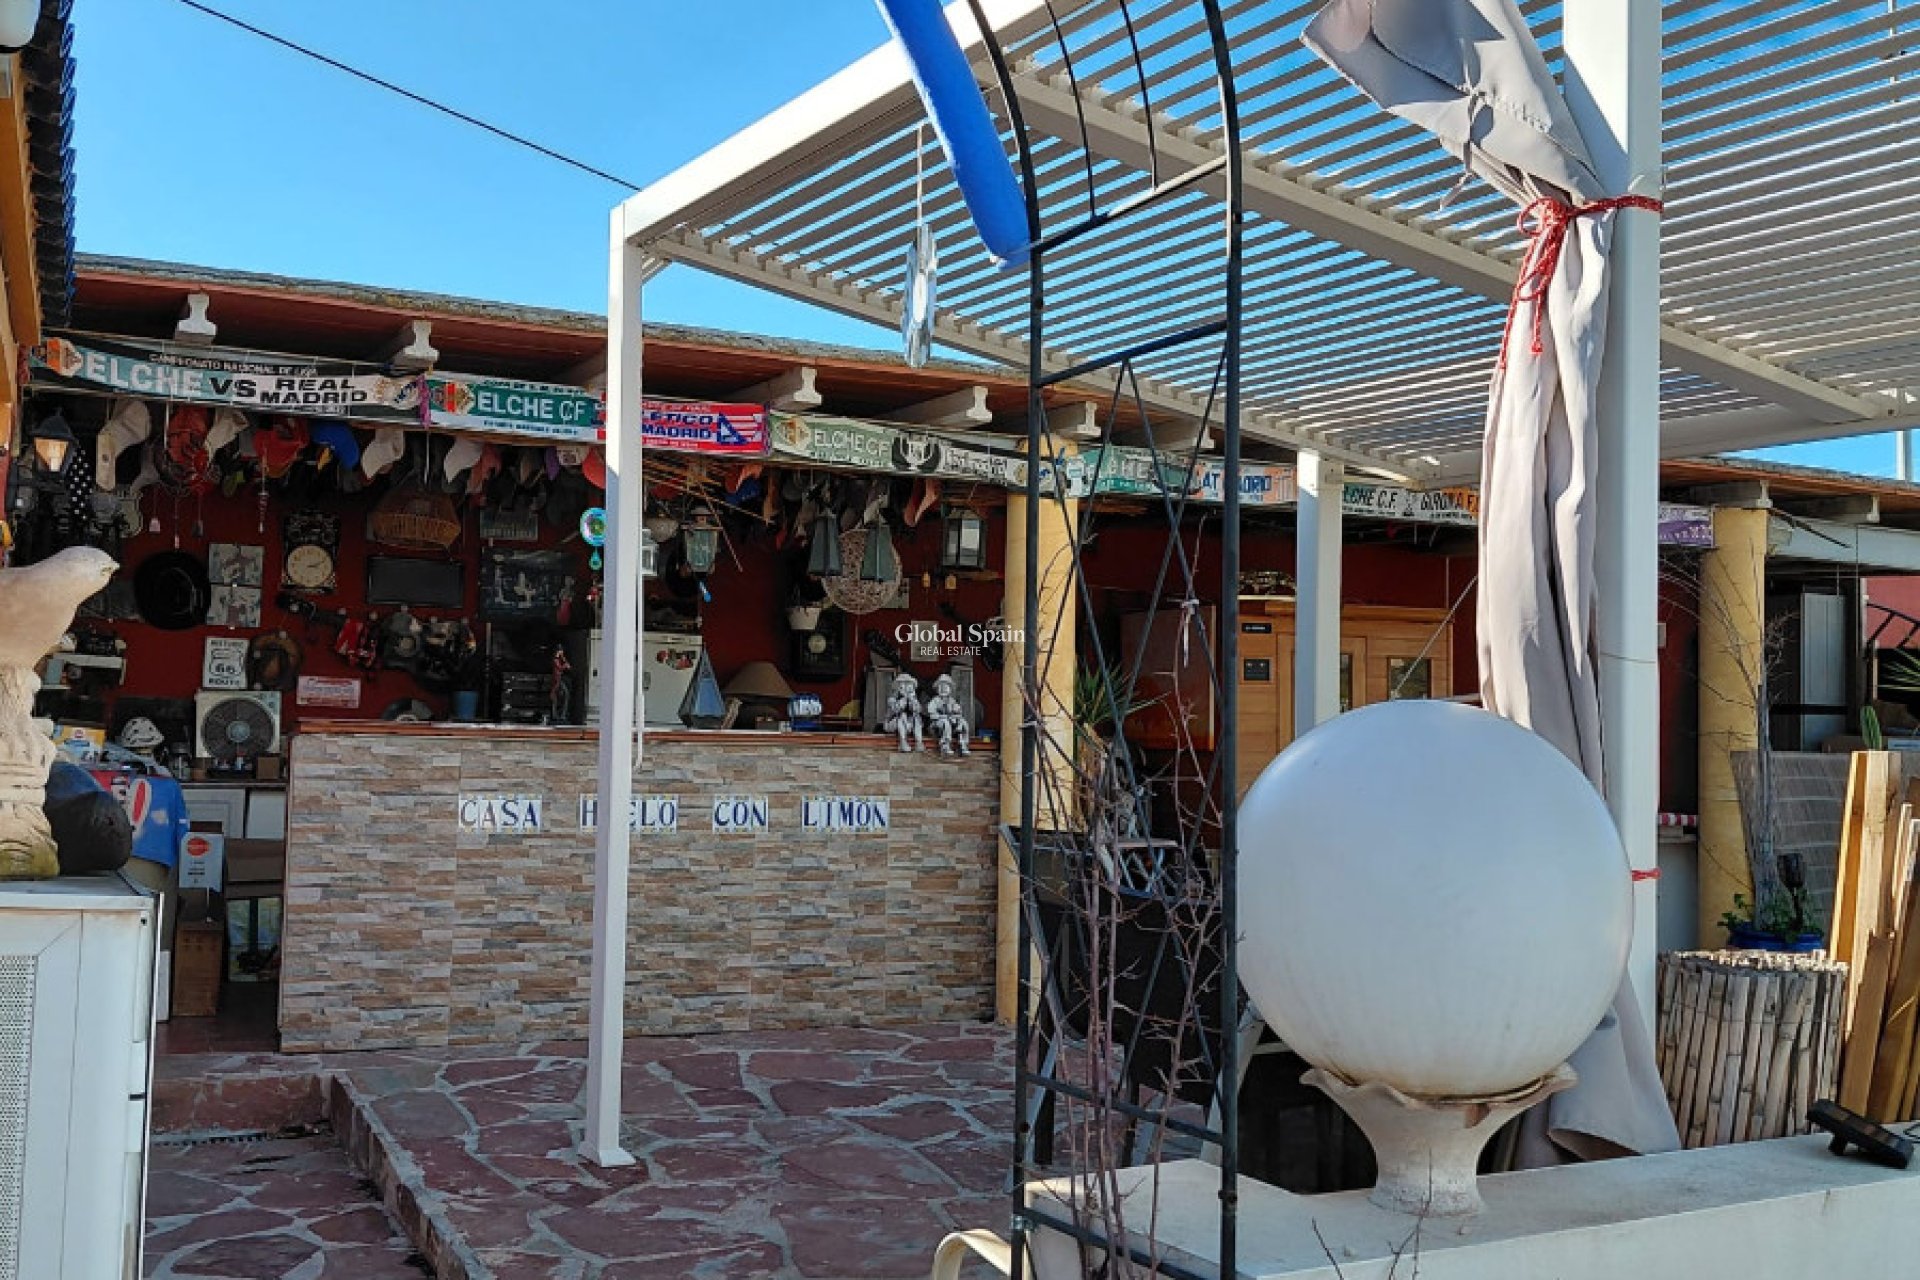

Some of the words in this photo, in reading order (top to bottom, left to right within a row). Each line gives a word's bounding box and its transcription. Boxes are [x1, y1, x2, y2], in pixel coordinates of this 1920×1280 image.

[86, 351, 201, 397] ELCHE
[208, 377, 258, 398] VS
[274, 378, 356, 391] REAL
[259, 390, 368, 404] MADRID
[477, 391, 554, 419] ELCHE
[559, 399, 587, 421] CF
[642, 423, 712, 440] MADRID
[814, 429, 865, 453] ELCHE
[460, 799, 539, 827] CASA
[581, 799, 676, 827] HLO
[714, 800, 767, 827] CON
